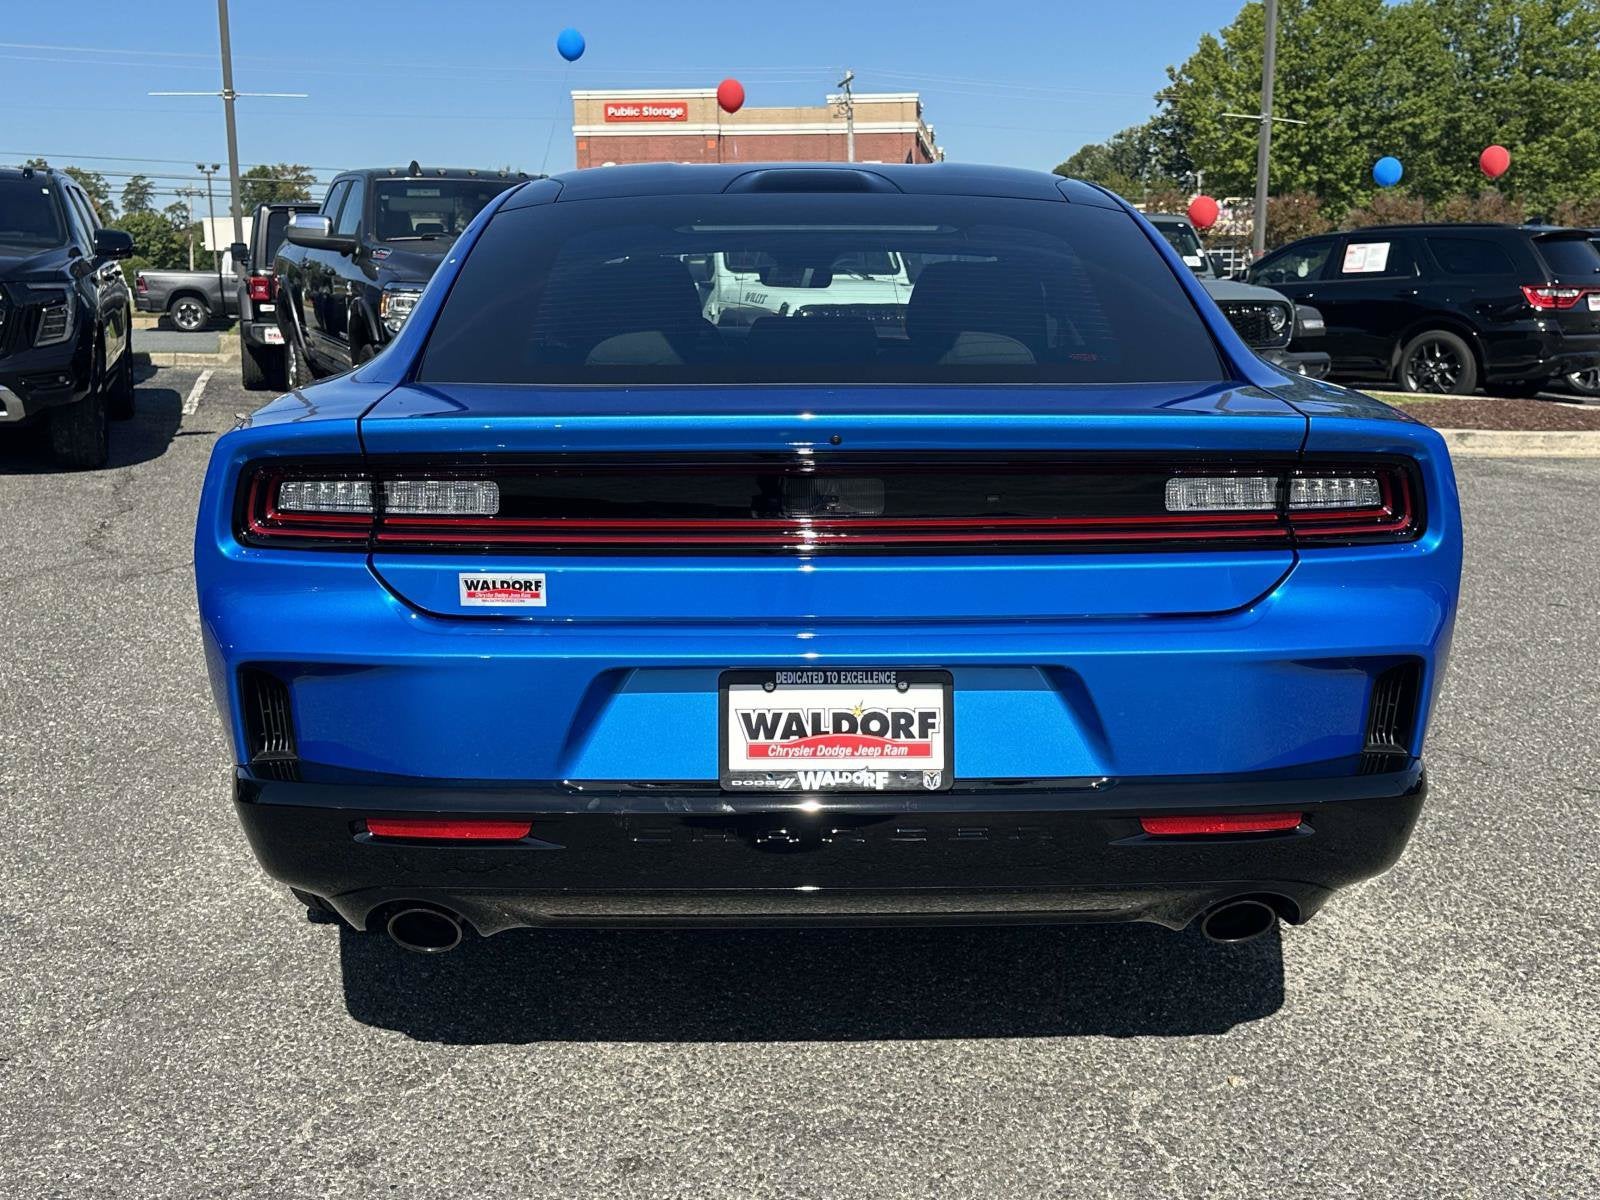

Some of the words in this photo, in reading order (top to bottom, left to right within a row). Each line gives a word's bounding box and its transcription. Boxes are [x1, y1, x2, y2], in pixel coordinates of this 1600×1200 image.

[608, 106, 640, 117] Public
[642, 105, 684, 119] Storage
[464, 579, 542, 592] WALDORF
[775, 671, 825, 684] DEDICATED
[826, 671, 839, 684] TO
[840, 671, 897, 684] EXCELLENCE
[740, 711, 938, 741] WALDORF
[767, 744, 816, 759] Chrysler
[816, 744, 853, 758] Dodge
[853, 744, 882, 758] Jeep
[882, 744, 909, 757] Ram
[797, 771, 889, 790] WALDORF
